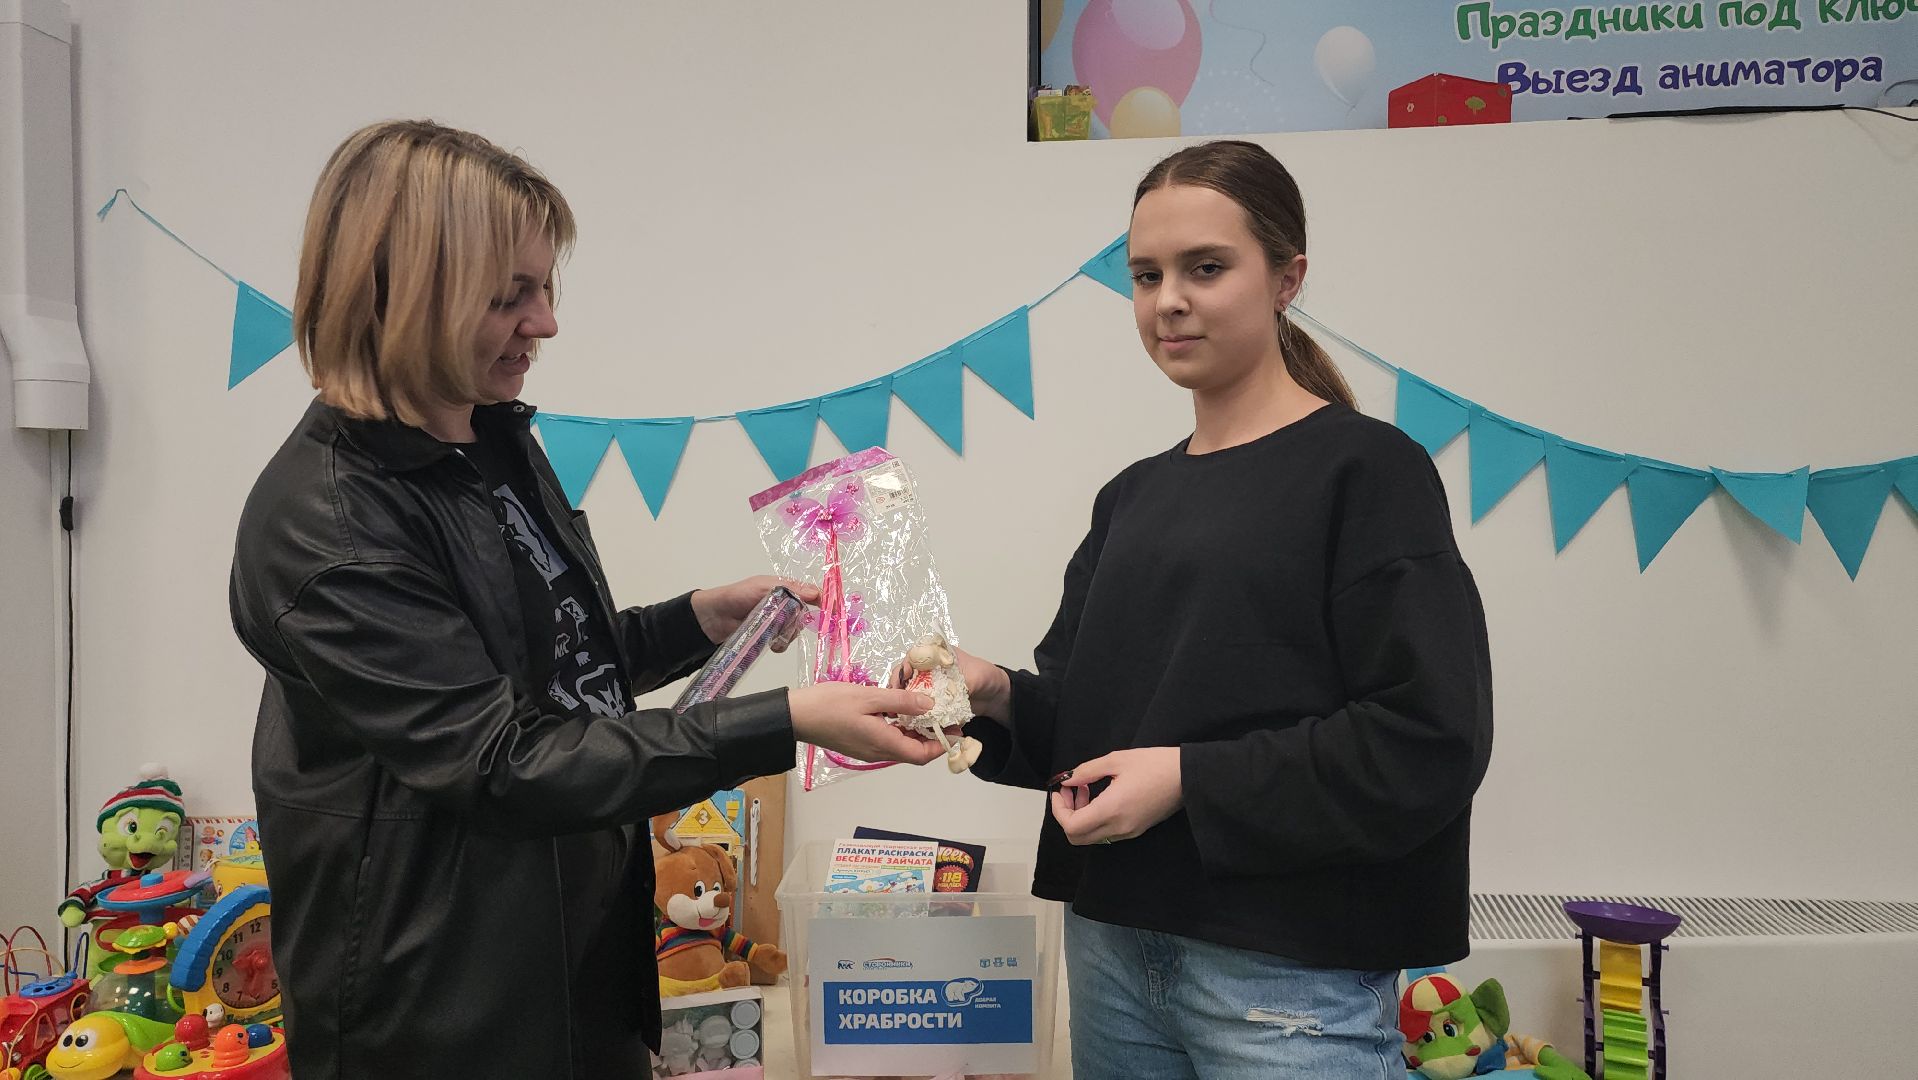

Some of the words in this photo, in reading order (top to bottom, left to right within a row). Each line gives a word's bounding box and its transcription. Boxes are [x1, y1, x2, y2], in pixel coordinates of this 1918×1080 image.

[1457, 1, 1703, 49] Праздники
[1718, 0, 1801, 31] под
[1498, 62, 1643, 96] Выезд
[1659, 56, 1883, 93] аниматора
[698, 809, 708, 825] 3
[837, 847, 877, 855] ПЛАКАТ
[878, 849, 935, 857] РАСКРАСКА
[835, 855, 883, 864] ВЕСЁЛЫЕ
[886, 856, 933, 866] ЗАЙЧАТА
[250, 921, 261, 933] 12
[232, 932, 244, 944] 11
[220, 950, 233, 961] 10
[216, 967, 223, 978] 9
[223, 983, 230, 993] 8
[236, 991, 243, 1001] 7
[838, 988, 938, 1005] КОРОБКА
[838, 1012, 963, 1030] ХРАБРОСТИ
